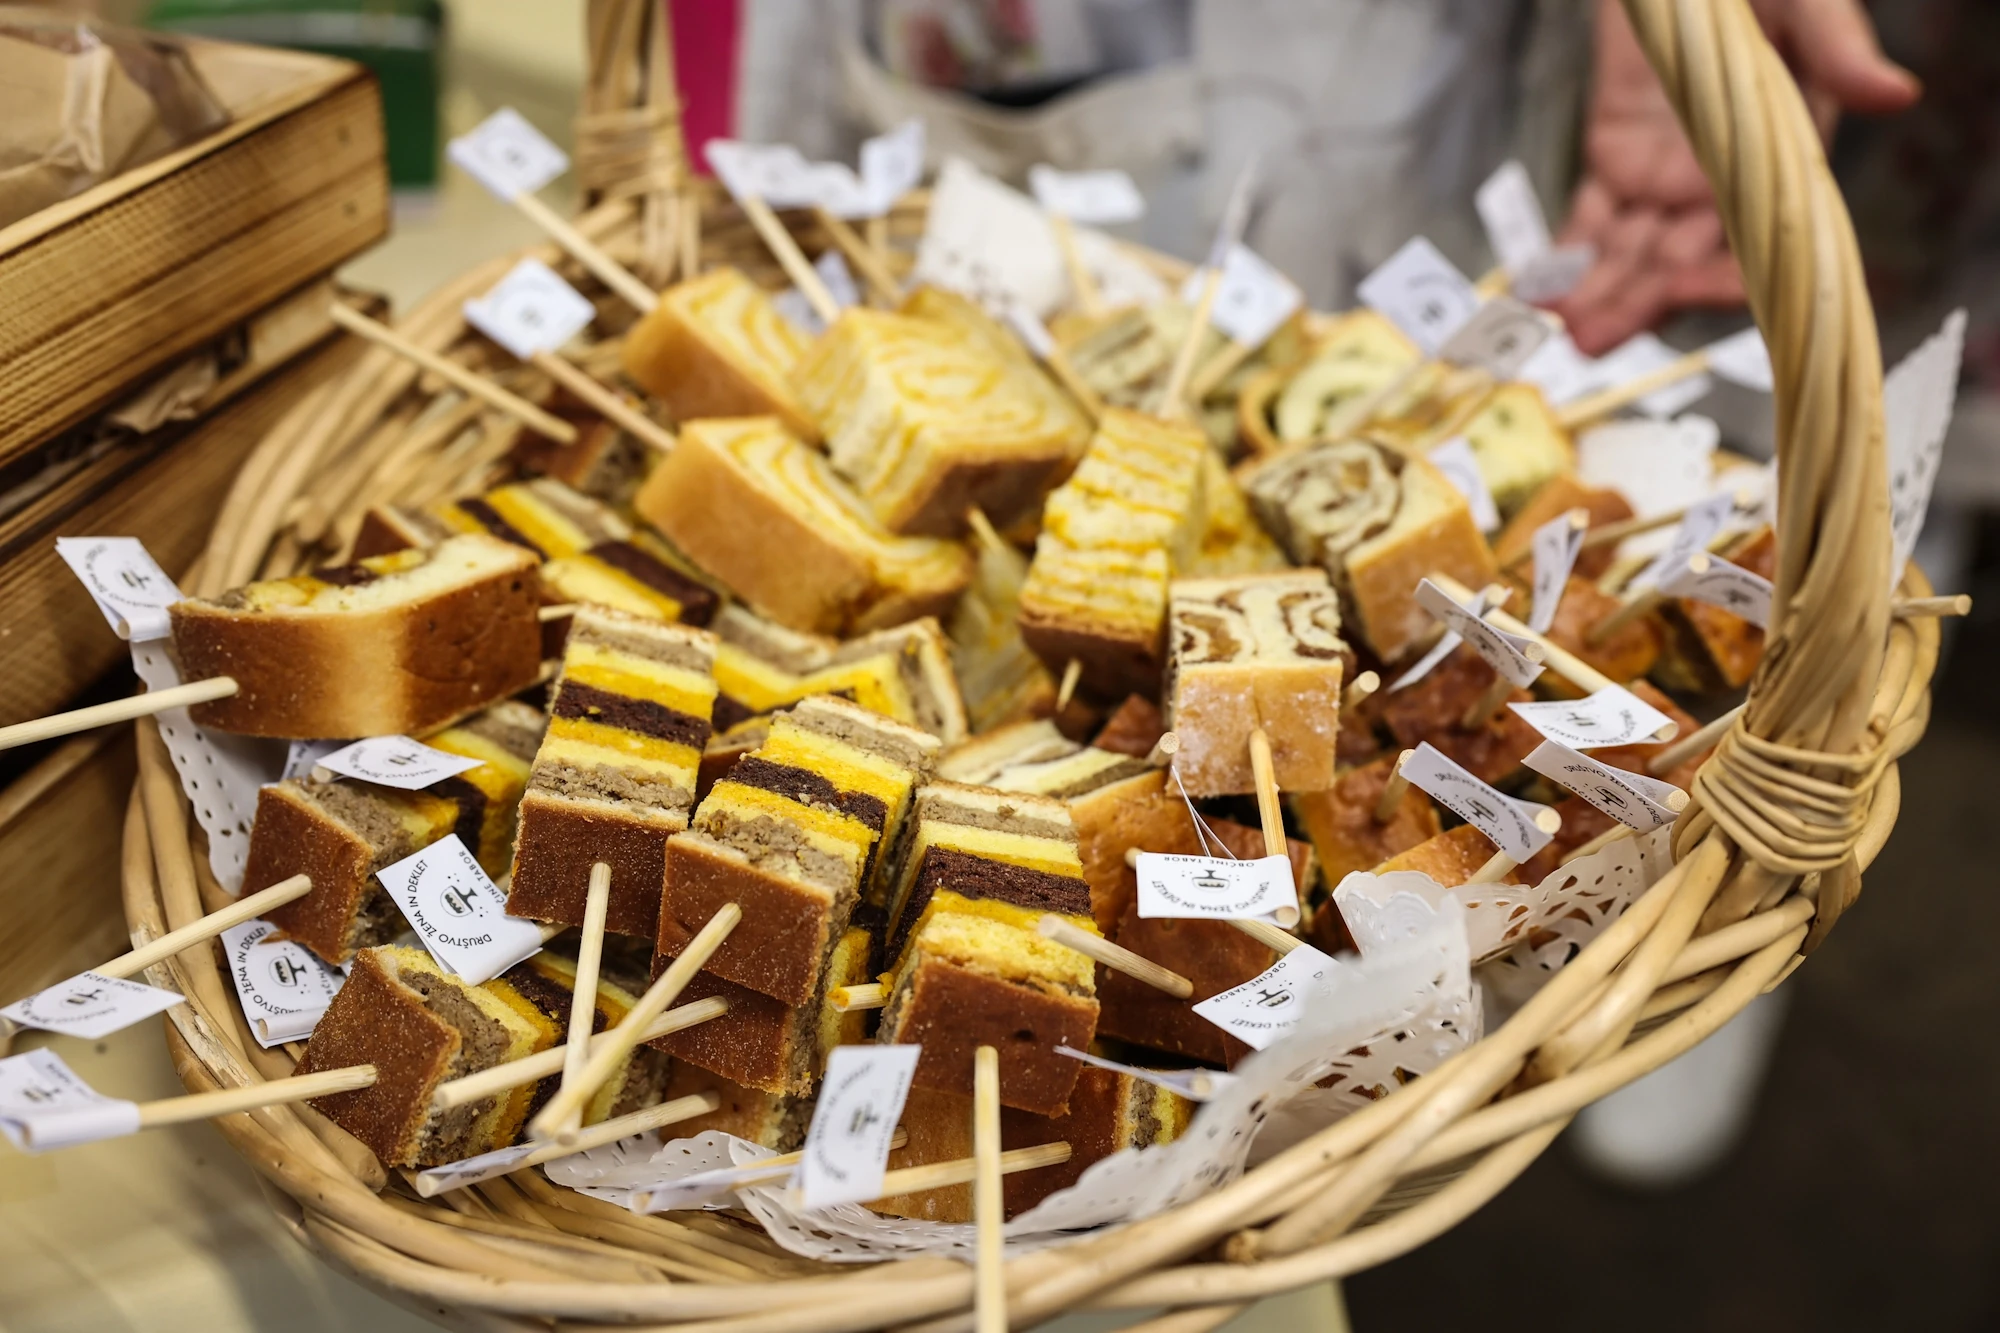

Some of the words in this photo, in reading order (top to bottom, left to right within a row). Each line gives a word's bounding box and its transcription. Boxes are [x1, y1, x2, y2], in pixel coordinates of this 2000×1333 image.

[1609, 775, 1635, 797] ŽENA
[1637, 797, 1650, 808] IN
[1563, 781, 1601, 808] OBČINE
[1606, 808, 1639, 831] TABOR
[1433, 792, 1472, 821] OBČINE
[1477, 823, 1507, 851] TABOR
[458, 850, 484, 882] TABOR
[1164, 856, 1202, 864] TABOR
[1209, 859, 1255, 868] OBČINE
[407, 859, 428, 893] DEKLET
[407, 896, 419, 908] IN
[484, 883, 509, 907] ČINE
[413, 909, 438, 938] ŽENA
[438, 933, 493, 949] DRUŠTVO
[237, 951, 247, 963] IN
[238, 966, 255, 994] ŽENA
[1249, 962, 1287, 989] OBČINE
[1213, 987, 1247, 1003] TABOR
